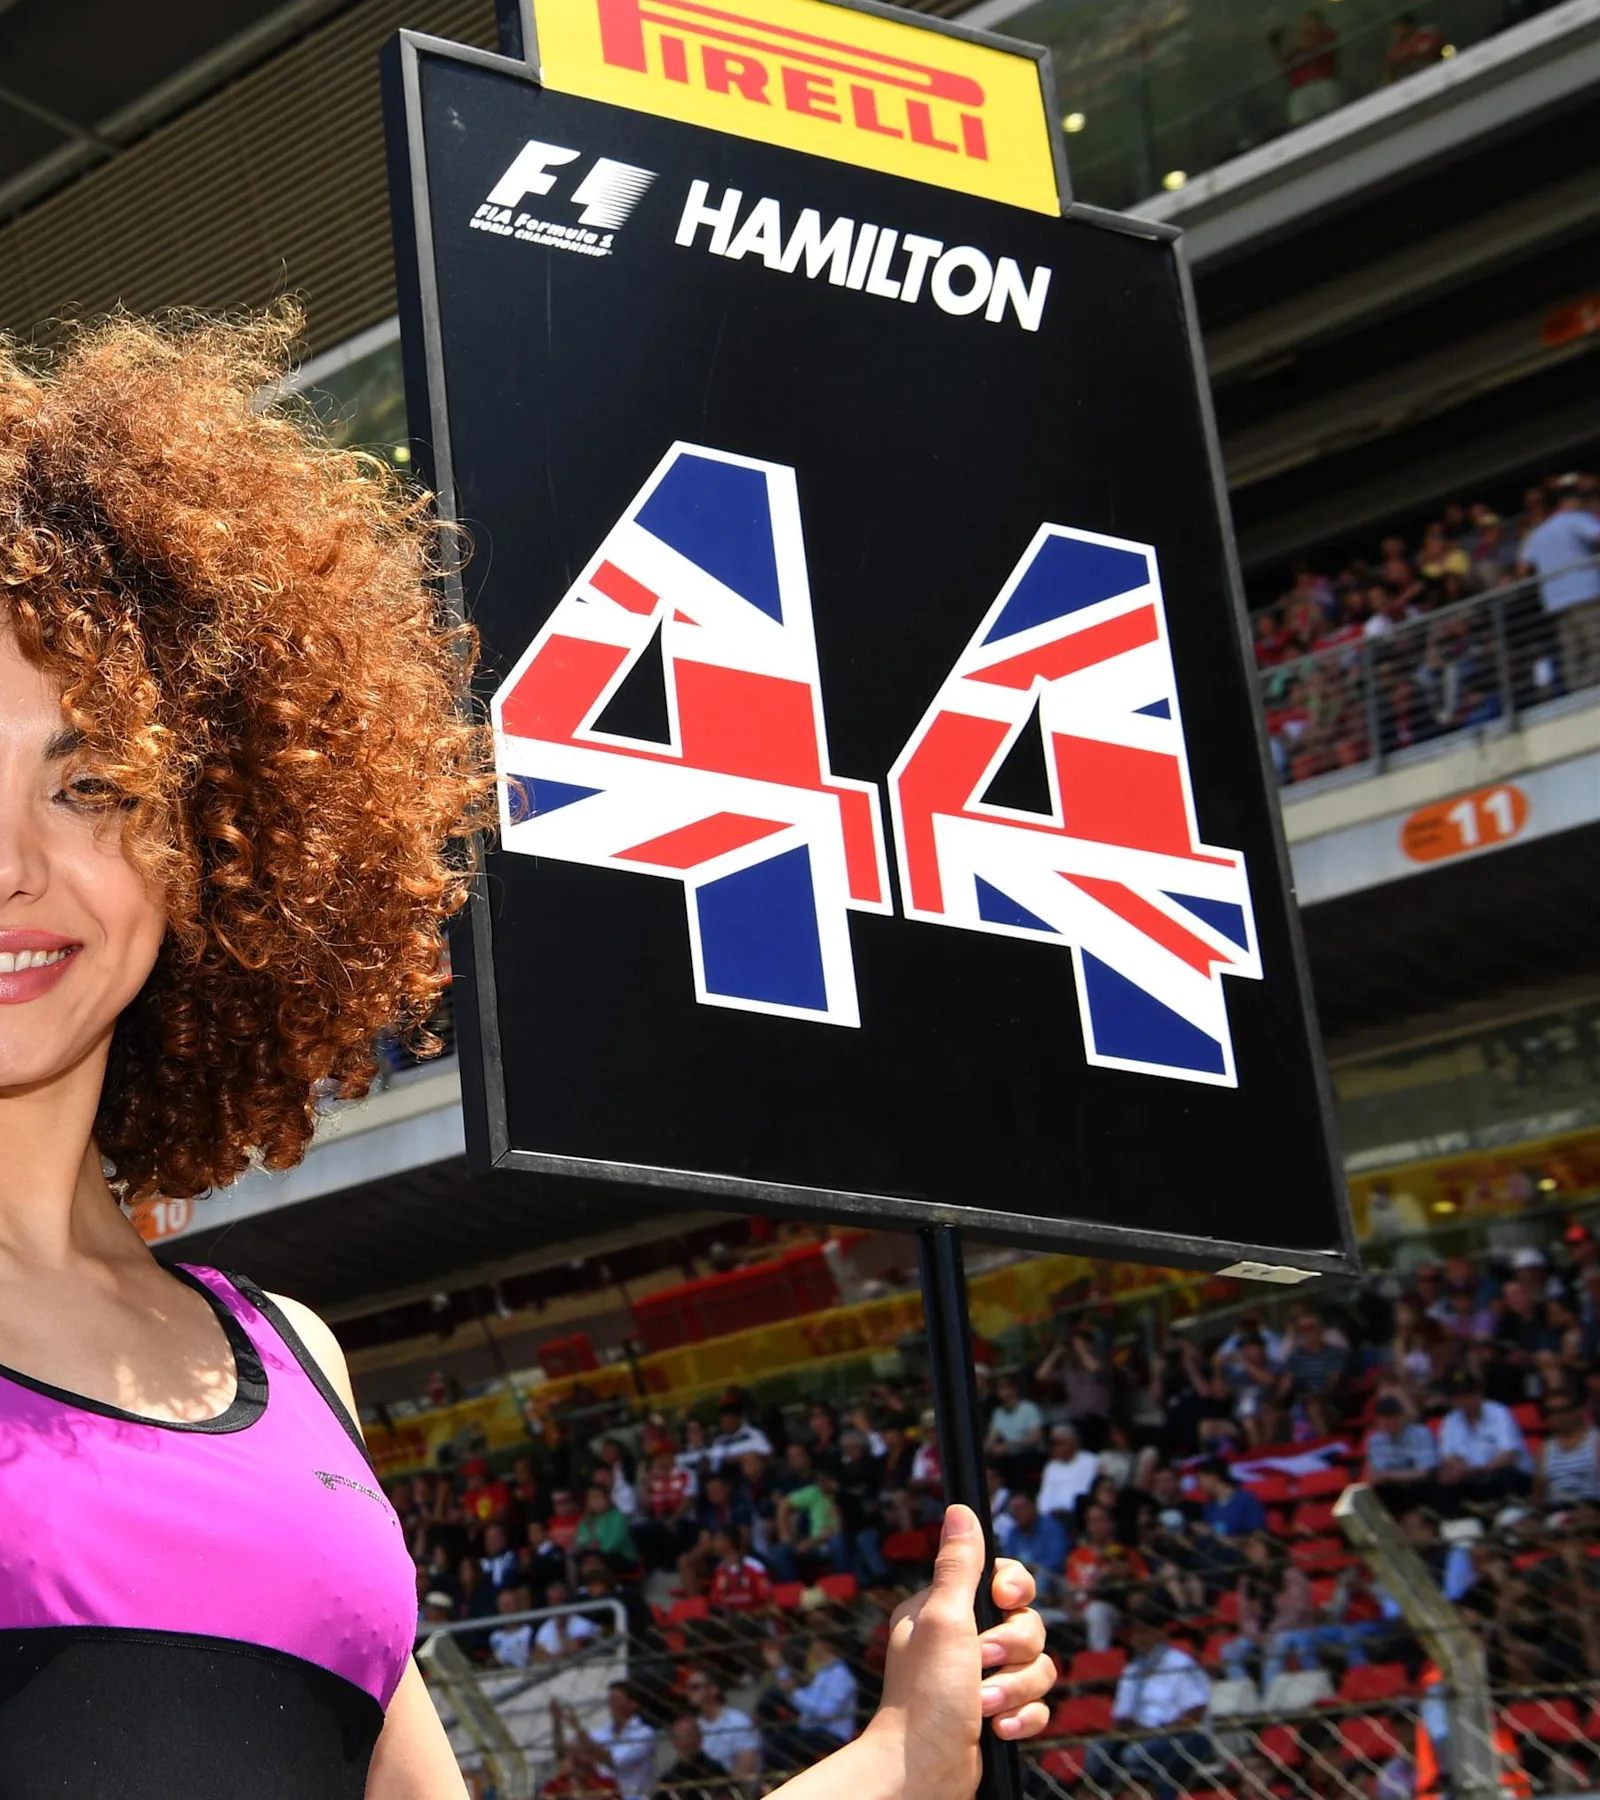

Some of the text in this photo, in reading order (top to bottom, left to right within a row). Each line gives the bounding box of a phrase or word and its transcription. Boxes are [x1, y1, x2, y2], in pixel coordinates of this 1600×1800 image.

[598, 0, 990, 162] PIRELLI
[469, 217, 607, 257] WORLD CHAMPIONSHIP
[474, 203, 615, 249] FIA Formula 1
[674, 179, 1053, 332] HAMILTON
[491, 440, 1263, 1088] 44
[1445, 790, 1515, 846] 11
[151, 1198, 188, 1235] 10
